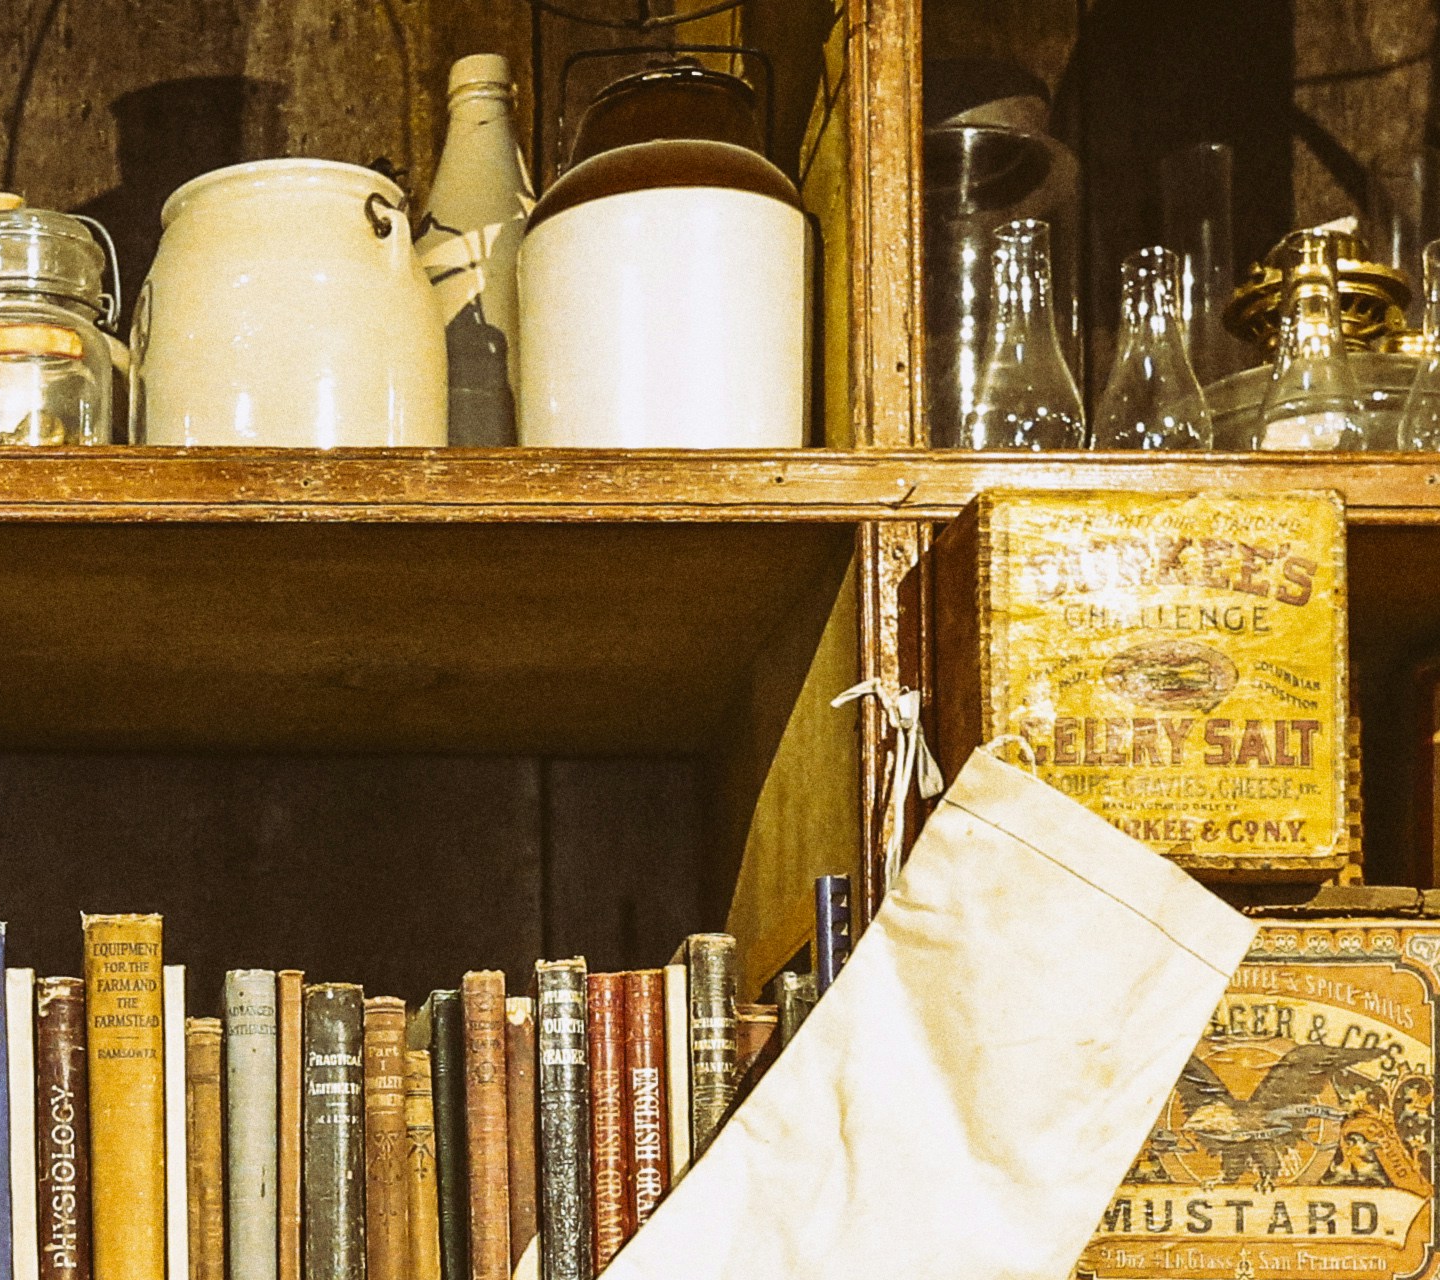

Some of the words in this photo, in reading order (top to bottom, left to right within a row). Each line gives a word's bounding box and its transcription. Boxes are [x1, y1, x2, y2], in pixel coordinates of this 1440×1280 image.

[1063, 604, 1271, 634] CHALLENGE
[1018, 716, 1195, 768] CELERY
[1204, 718, 1320, 768] SALT
[92, 942, 159, 959] EQUIPMENT
[93, 1013, 160, 1029] FARMSTEAD
[51, 1084, 77, 1271] PHYSIOLOGY
[1102, 1197, 1398, 1237] MUSTARD.
